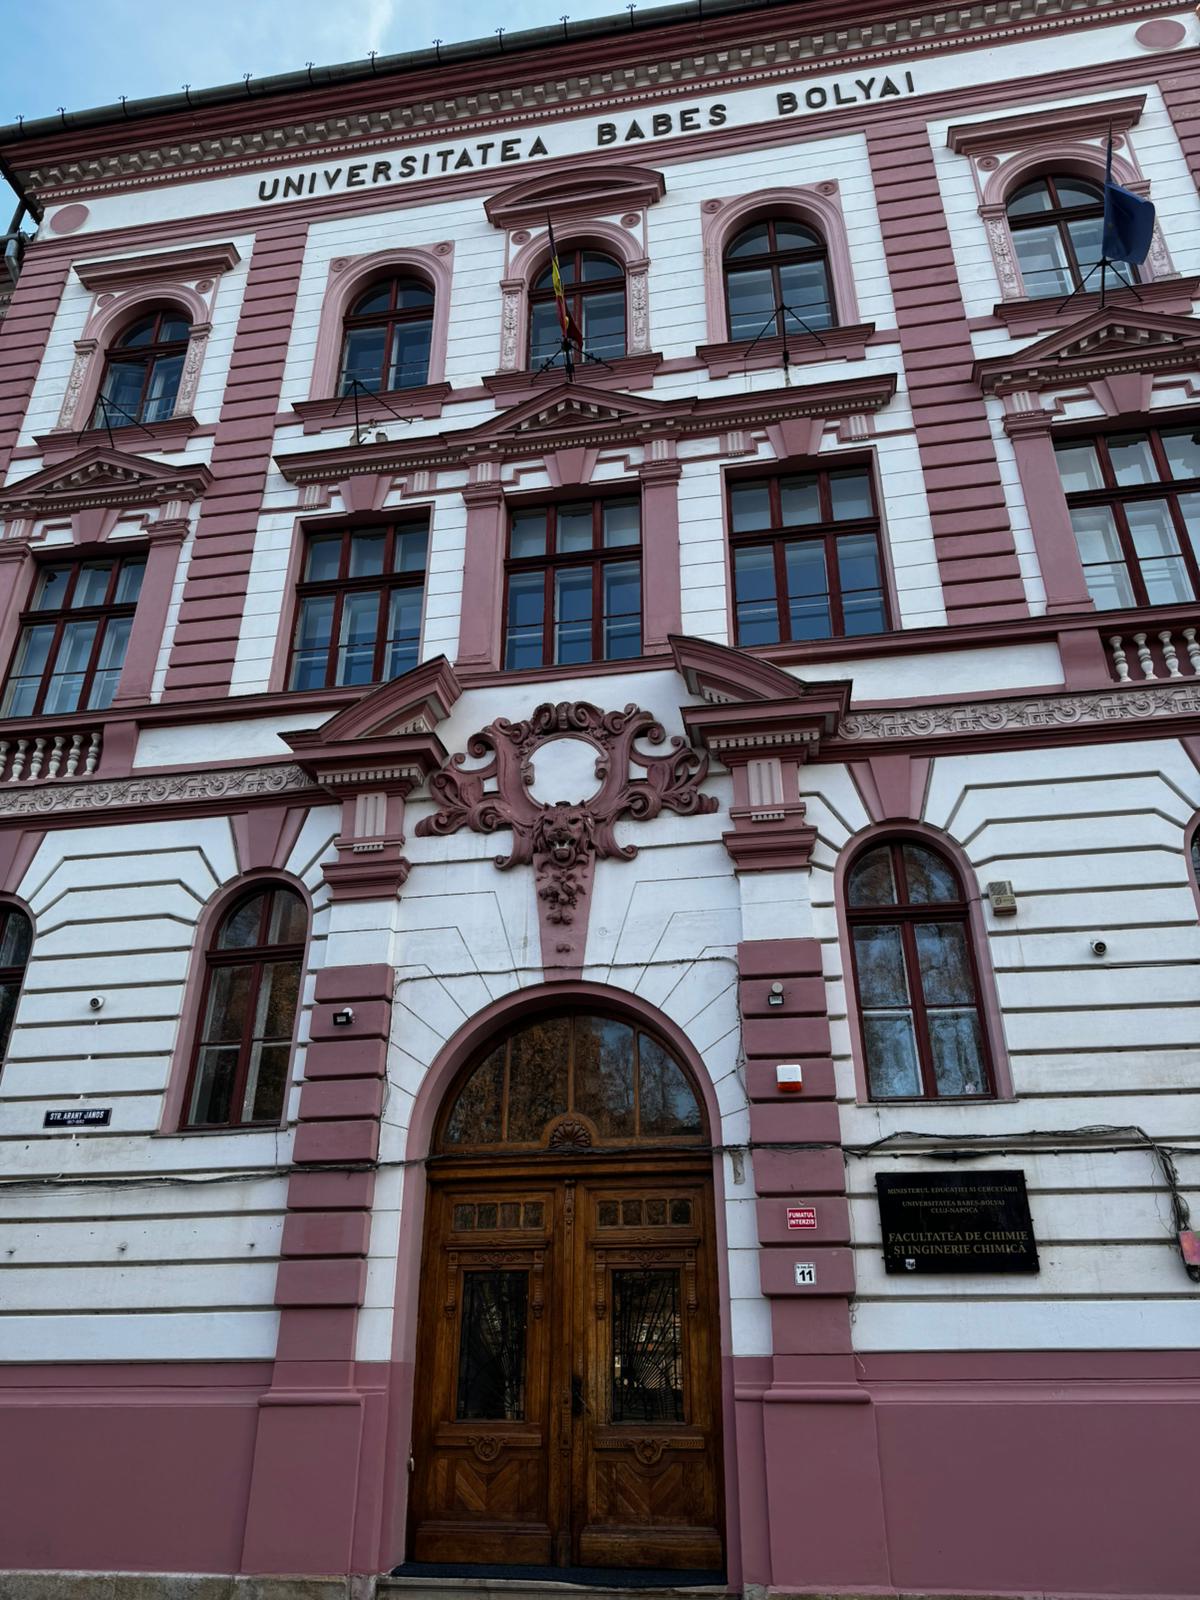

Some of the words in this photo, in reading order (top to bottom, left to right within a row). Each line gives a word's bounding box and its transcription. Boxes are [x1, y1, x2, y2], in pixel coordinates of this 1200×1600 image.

[258, 136, 549, 201] UNIVERSITATEA
[597, 104, 728, 146] BABES
[776, 71, 915, 115] BOLYAI
[63, 1112, 83, 1120] ARANY
[887, 1187, 930, 1195] MINISTERUL
[888, 1231, 963, 1242] FACULTATEA
[965, 1231, 981, 1241] DE
[984, 1231, 1029, 1241] CHIMIE
[908, 1244, 970, 1254] INGINERIE
[799, 1269, 813, 1282] 11
